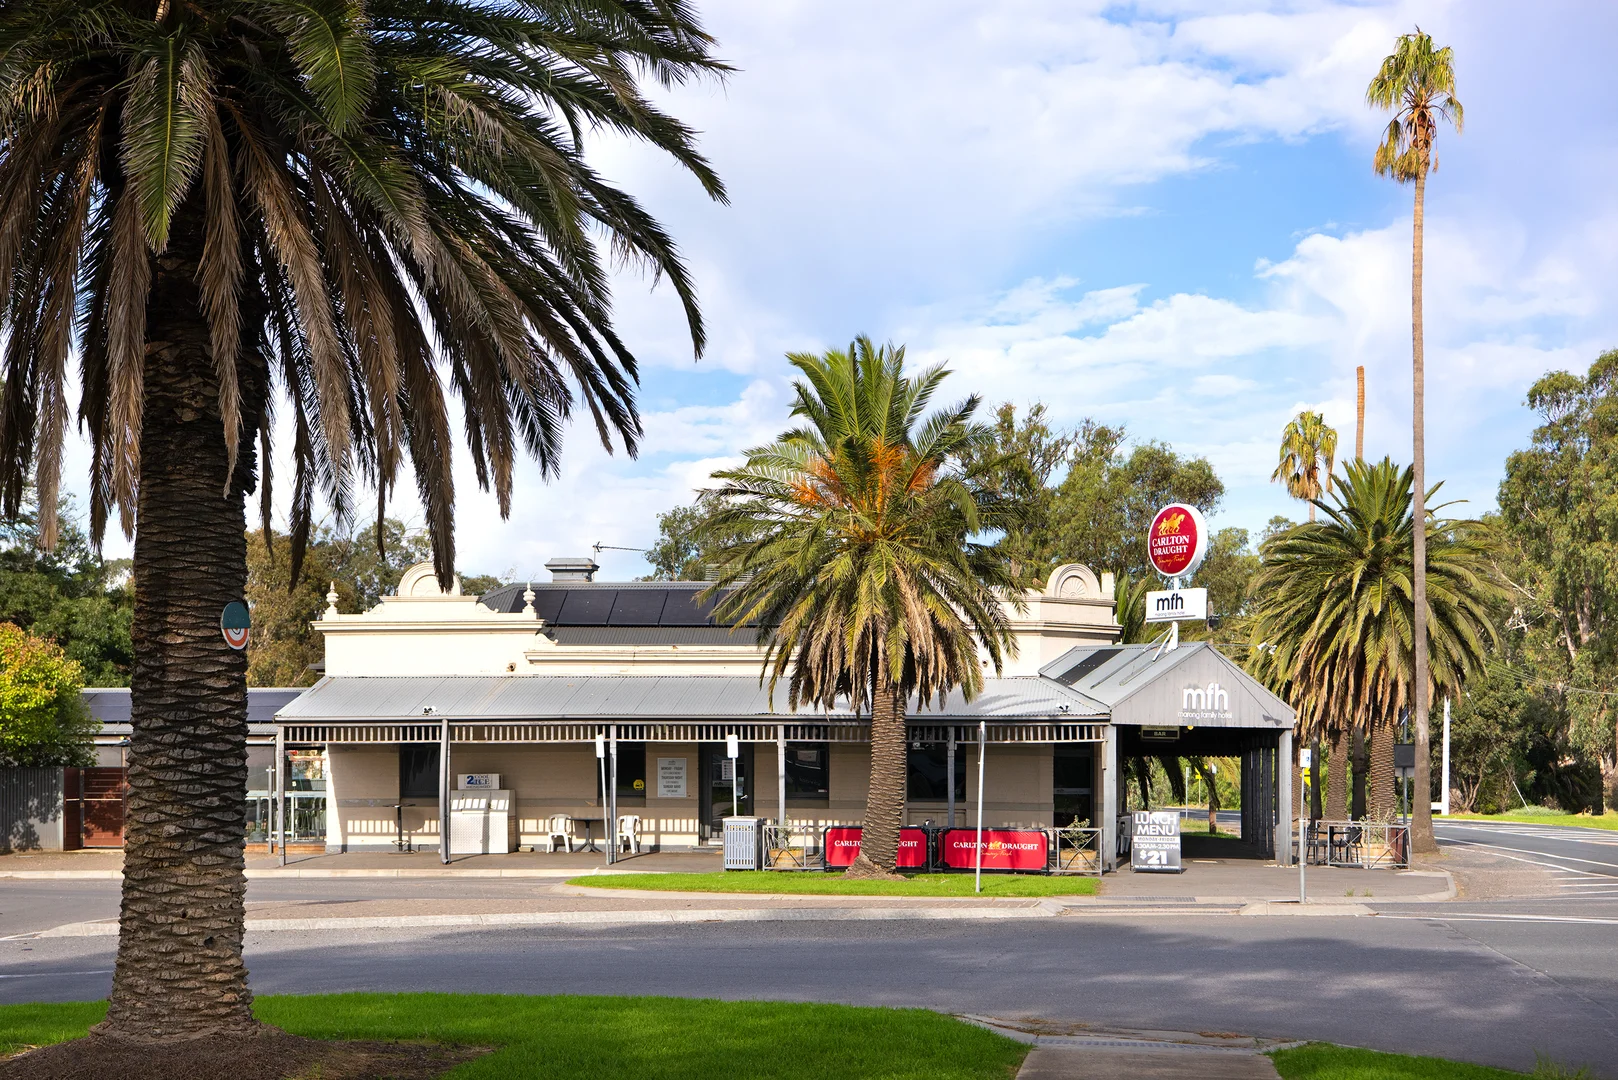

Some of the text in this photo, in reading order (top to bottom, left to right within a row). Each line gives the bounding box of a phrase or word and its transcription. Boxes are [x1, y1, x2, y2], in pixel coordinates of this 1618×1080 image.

[1152, 535, 1190, 547] CARLTON
[1153, 545, 1188, 555] DRAUGHT
[1157, 593, 1184, 611] mfh
[1183, 683, 1228, 710] mfh
[1201, 711, 1217, 719] family
[466, 775, 474, 784] 2
[1135, 813, 1177, 824] LUNCH
[1137, 825, 1174, 835] MENU
[953, 841, 988, 849] CARLTN
[1140, 850, 1167, 864] $21
